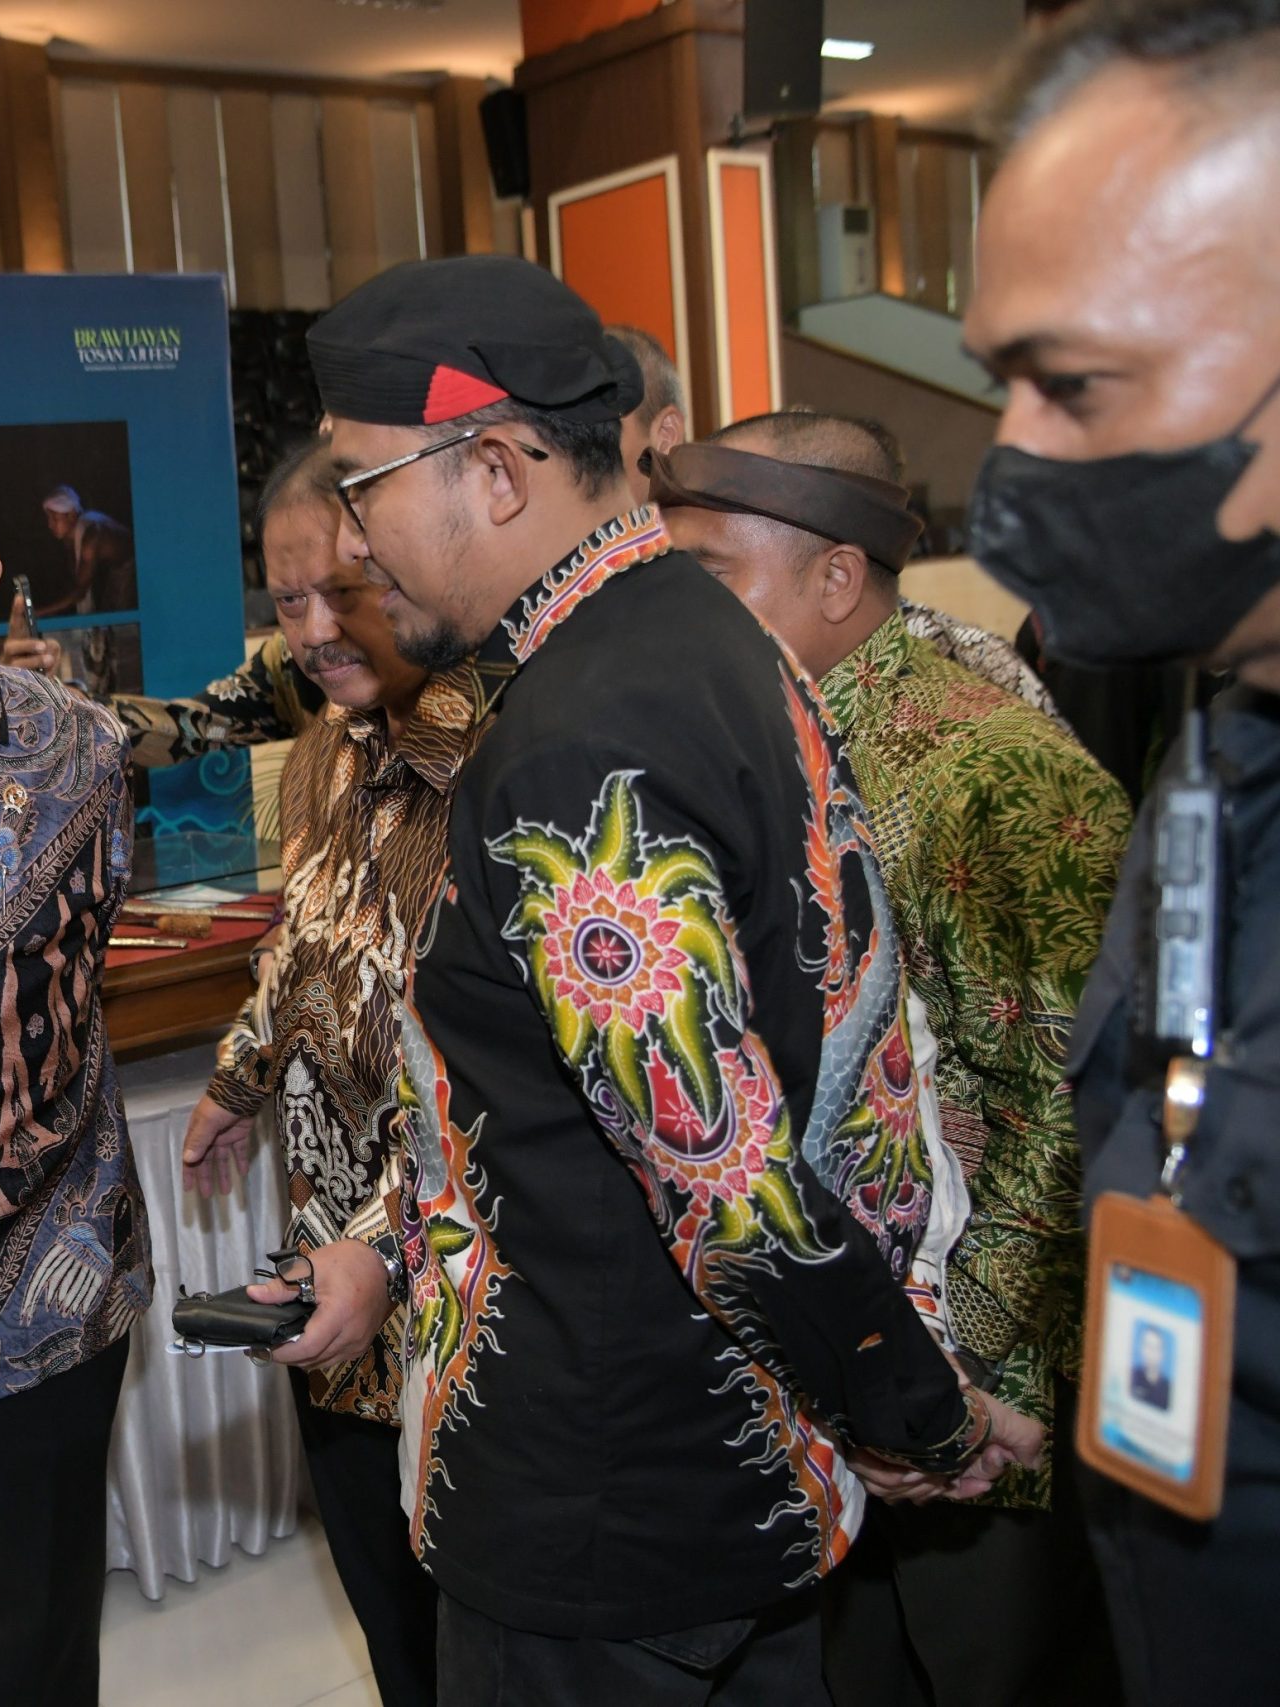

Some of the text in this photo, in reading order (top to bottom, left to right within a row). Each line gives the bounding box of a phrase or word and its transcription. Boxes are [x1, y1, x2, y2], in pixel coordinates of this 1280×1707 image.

[74, 327, 180, 348] BRAWIJAYAN
[78, 348, 124, 363] TOSAN
[149, 347, 180, 362] FEST
